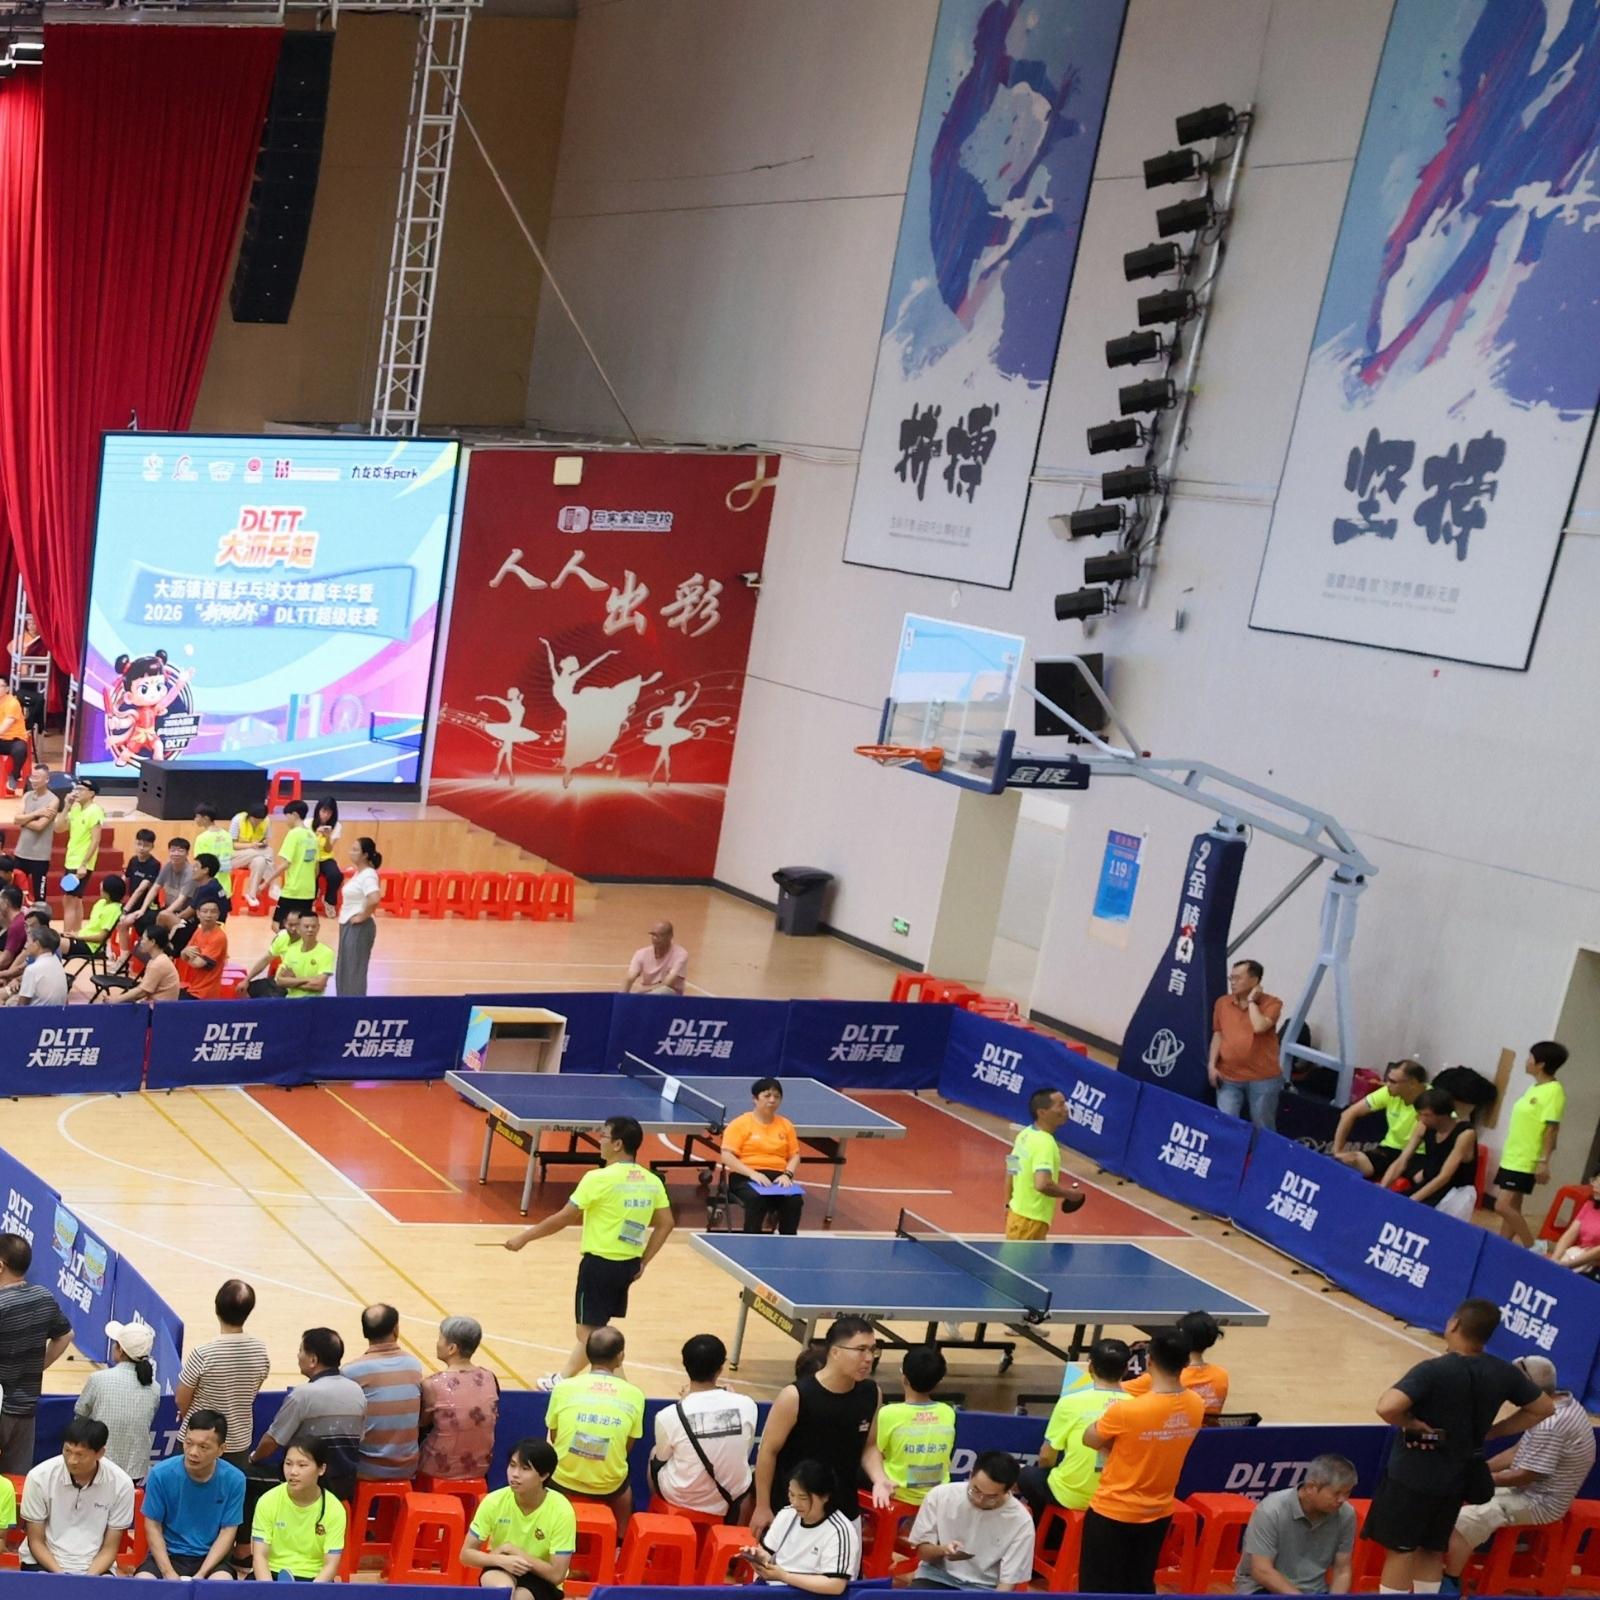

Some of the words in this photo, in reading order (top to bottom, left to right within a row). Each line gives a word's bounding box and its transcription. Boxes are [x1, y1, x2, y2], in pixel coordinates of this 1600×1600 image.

[241, 510, 303, 532] DLTT
[217, 535, 316, 566] 大沥乒超
[153, 578, 374, 603] 大沥镇首届乒乓球文旅嘉年华暨
[489, 548, 724, 637] 人人出彩
[144, 604, 182, 622] 2026
[275, 605, 380, 627] DLTT超级联赛
[1012, 766, 1070, 783] 金陵
[39, 1028, 93, 1046] DLTT
[204, 1023, 257, 1041] DLTT
[354, 1020, 408, 1037] DLTT
[668, 1019, 728, 1038] DLTT
[842, 1025, 899, 1042] DLTT
[27, 1047, 100, 1067] 大沥乒超
[192, 1042, 263, 1061] 大沥乒超
[342, 1039, 414, 1057] 大沥乒超
[655, 1037, 733, 1058] 大沥乒超
[828, 1043, 904, 1062] 大沥乒超
[982, 1043, 1022, 1070] DLTT
[972, 1061, 1023, 1093] 大沥乒超
[1170, 1122, 1208, 1152] DLTT
[1158, 1143, 1211, 1178] 大沥乒超
[1281, 1171, 1320, 1203] DLTT
[1266, 1192, 1318, 1231] 大沥乒超
[1379, 1223, 1429, 1258] DLTT
[1365, 1244, 1429, 1288] 大沥乒超
[1510, 1281, 1557, 1319] DLTT
[753, 1296, 778, 1321] DOUBLE
[776, 1314, 794, 1333] FISH
[1128, 1356, 1143, 1376] 4
[576, 1412, 621, 1427] 和美泌冲
[904, 1442, 948, 1454] 和美泌冲
